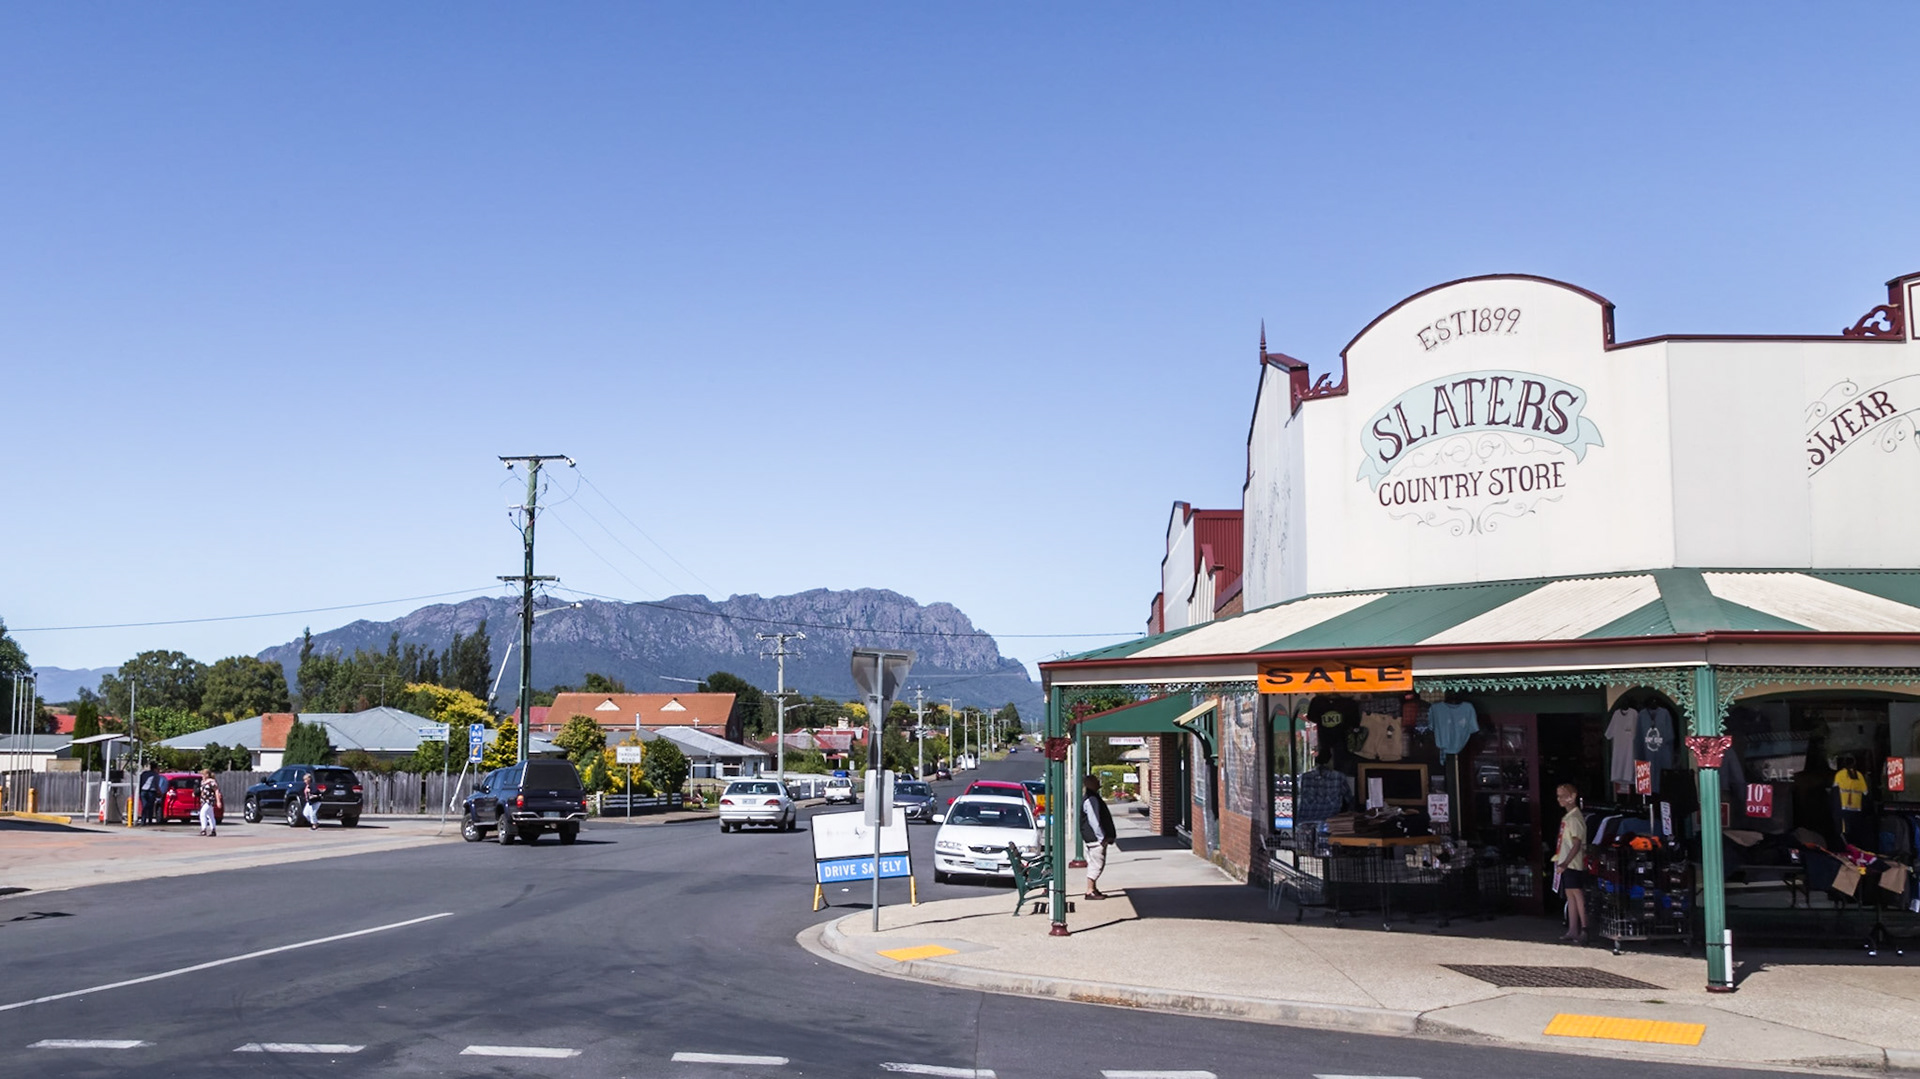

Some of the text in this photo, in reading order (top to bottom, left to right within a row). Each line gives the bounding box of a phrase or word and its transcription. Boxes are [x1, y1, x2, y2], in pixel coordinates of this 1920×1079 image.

[1372, 376, 1579, 463] SLATERS
[1378, 461, 1567, 507] COUNTRY STORE
[1265, 664, 1406, 685] SALE
[1762, 768, 1795, 782] SALE
[1887, 759, 1903, 775] 20%
[1638, 778, 1650, 792] OFF
[1888, 774, 1902, 789] OFF
[1746, 805, 1769, 813] OFF
[824, 860, 902, 878] DRIVE SAELY
